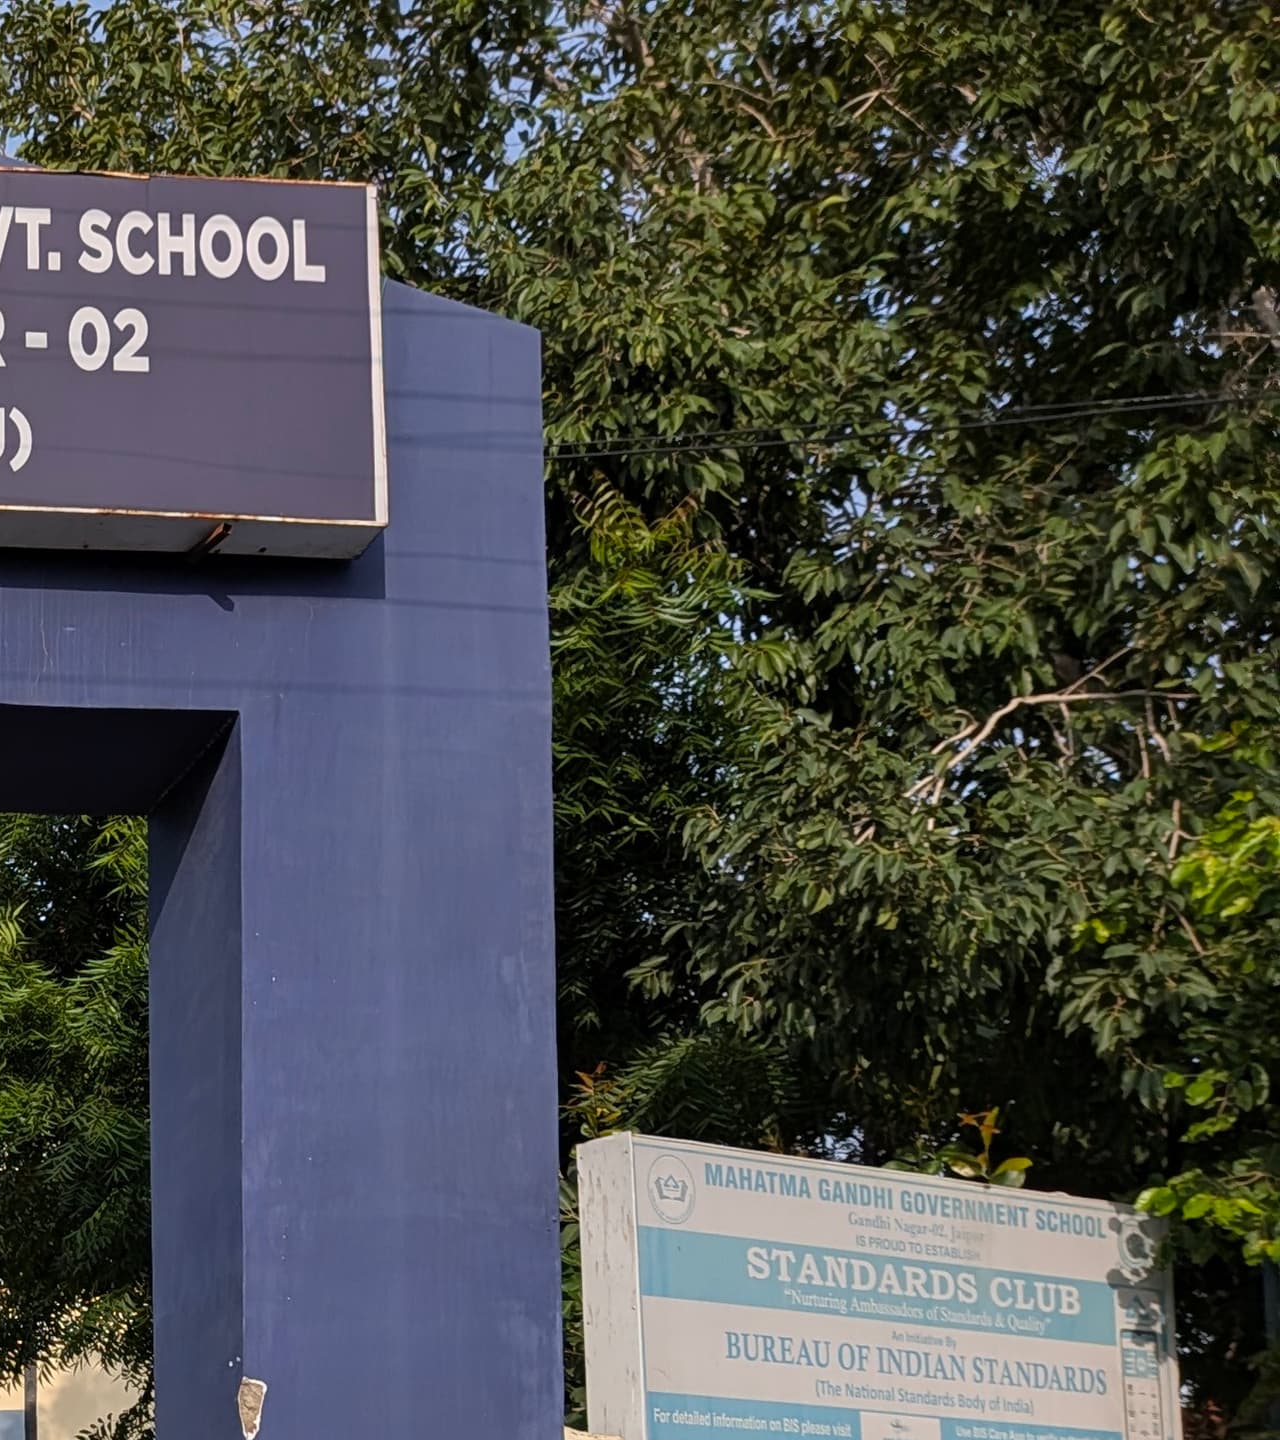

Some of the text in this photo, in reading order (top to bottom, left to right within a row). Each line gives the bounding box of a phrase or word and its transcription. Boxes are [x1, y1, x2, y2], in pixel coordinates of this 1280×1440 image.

[78, 209, 326, 283] SCHOOL
[68, 306, 150, 373] 02
[704, 1162, 1107, 1239] MAHATMA GANDHI GOVERNMENT SCHOOL
[848, 1211, 891, 1231] Gandhi
[868, 1237, 907, 1252] PROUD
[746, 1246, 1081, 1316] STANDARDS CLUB
[850, 1299, 923, 1320] Ambassadors
[725, 1331, 1107, 1395] BUREAU OF INDIAN STANDARDS
[654, 1408, 767, 1430] For detailed information
[815, 1379, 986, 1413] (The National Standards Body
